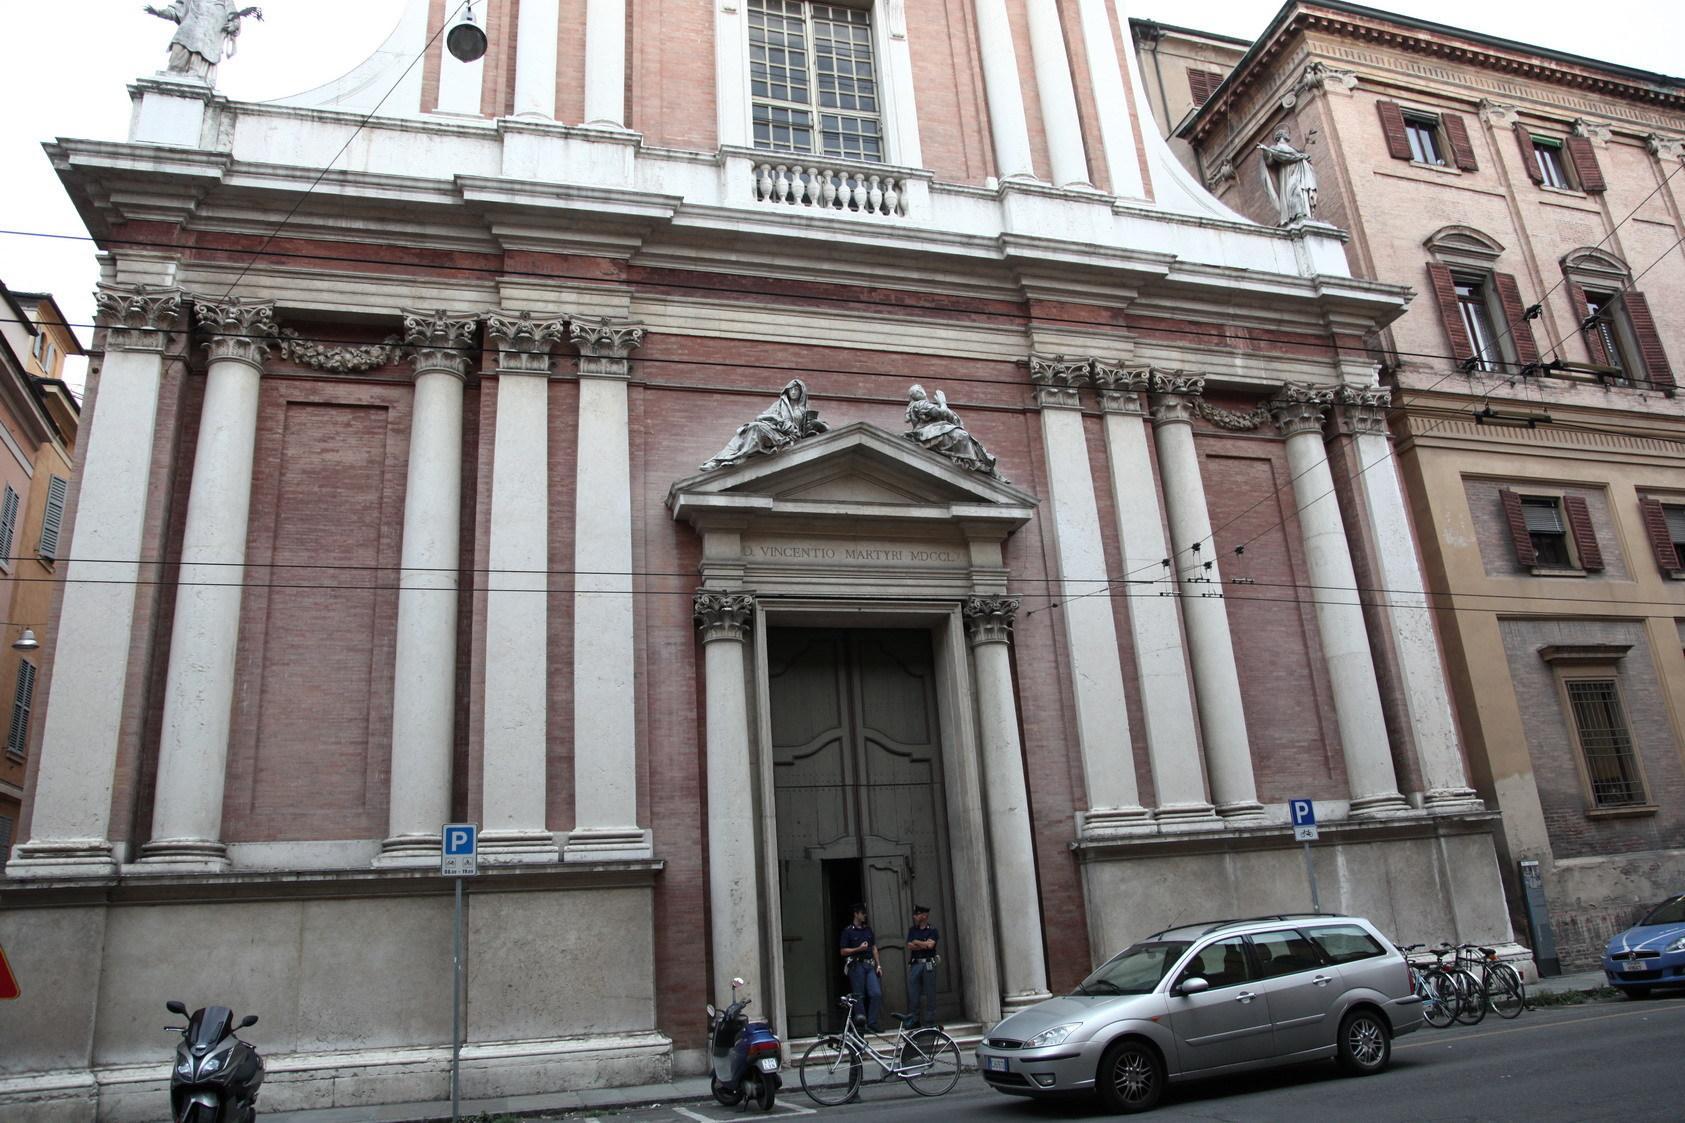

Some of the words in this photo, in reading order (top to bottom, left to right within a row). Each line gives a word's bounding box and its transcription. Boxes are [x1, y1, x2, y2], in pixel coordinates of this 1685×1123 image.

[760, 546, 835, 559] VINCENTIO
[845, 549, 902, 561] MARTYRI
[1295, 802, 1309, 824] P
[451, 831, 468, 852] P
